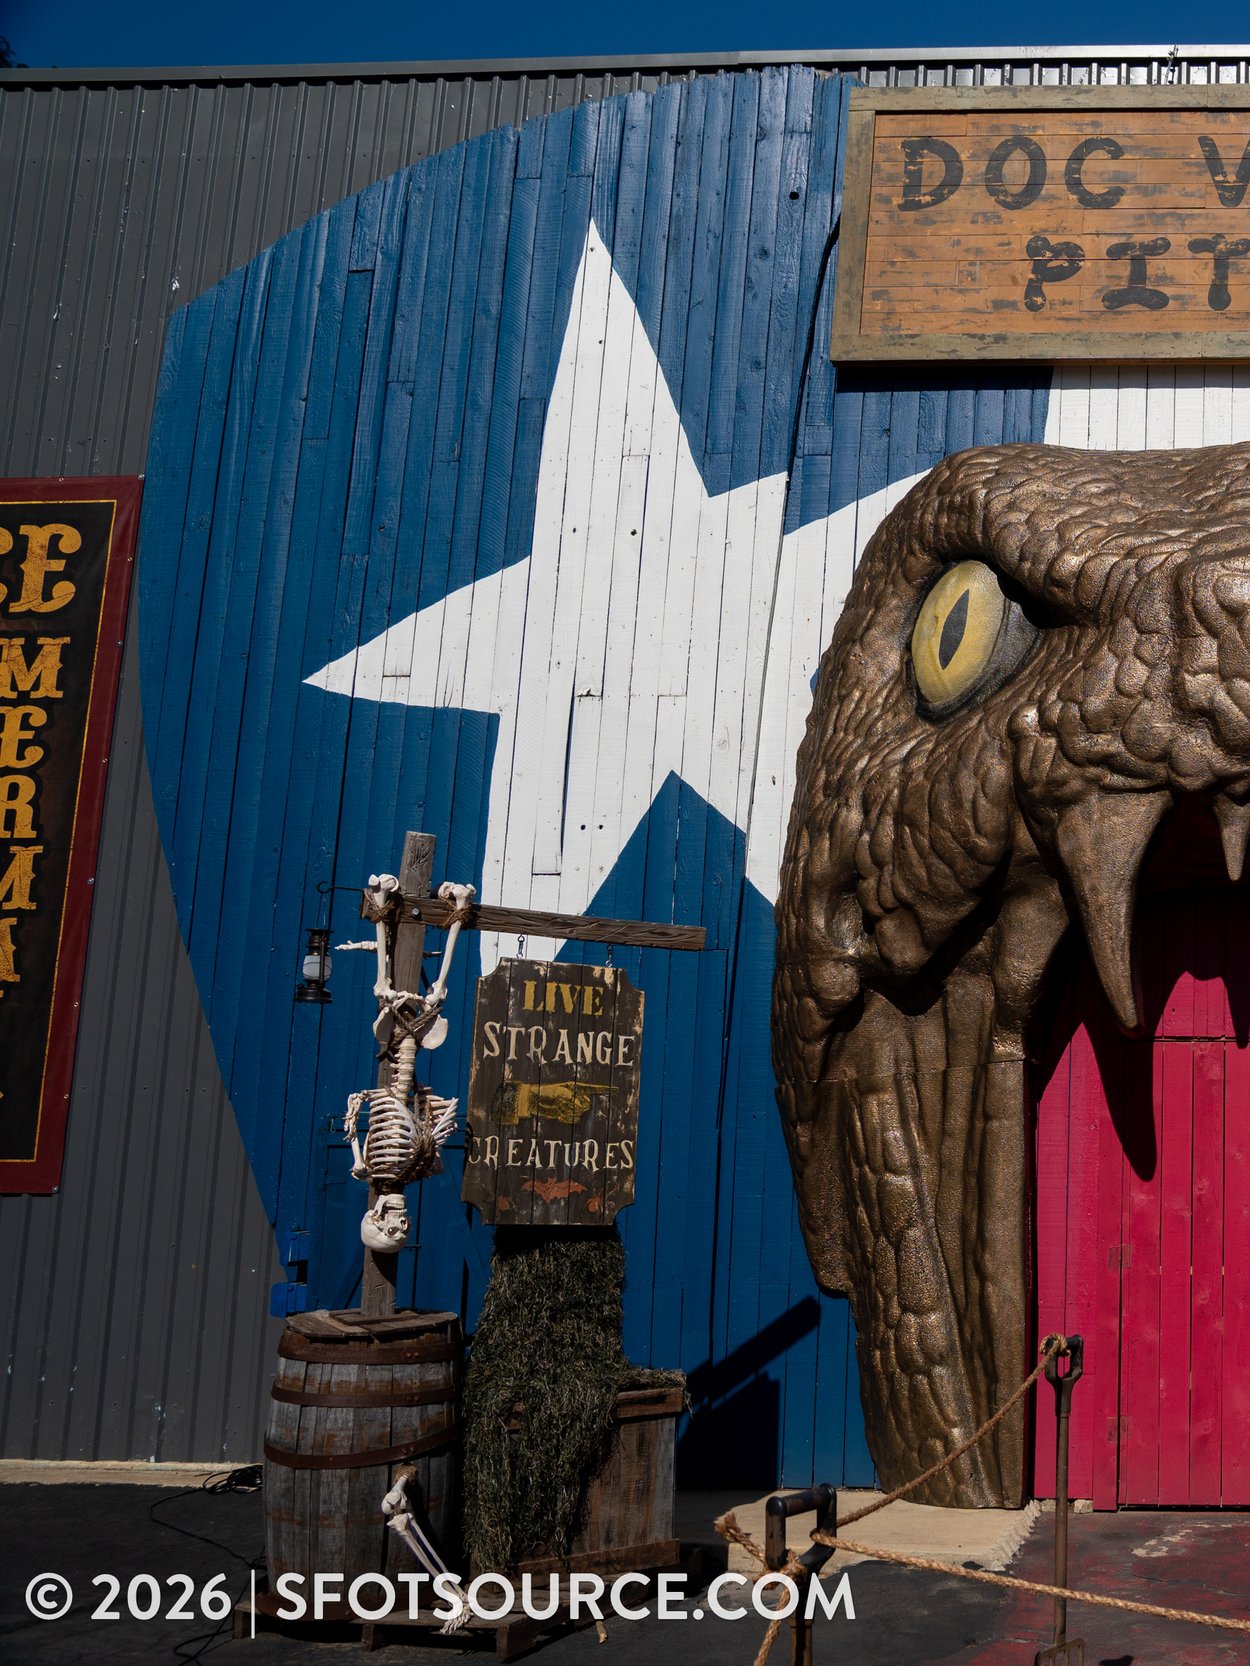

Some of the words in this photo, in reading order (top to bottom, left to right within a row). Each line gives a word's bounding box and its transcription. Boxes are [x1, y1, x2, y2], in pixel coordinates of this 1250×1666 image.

[898, 136, 1125, 211] DOC
[523, 979, 604, 1016] LIVE
[483, 1021, 635, 1067] STRANGE
[468, 1135, 635, 1172] CREATURES
